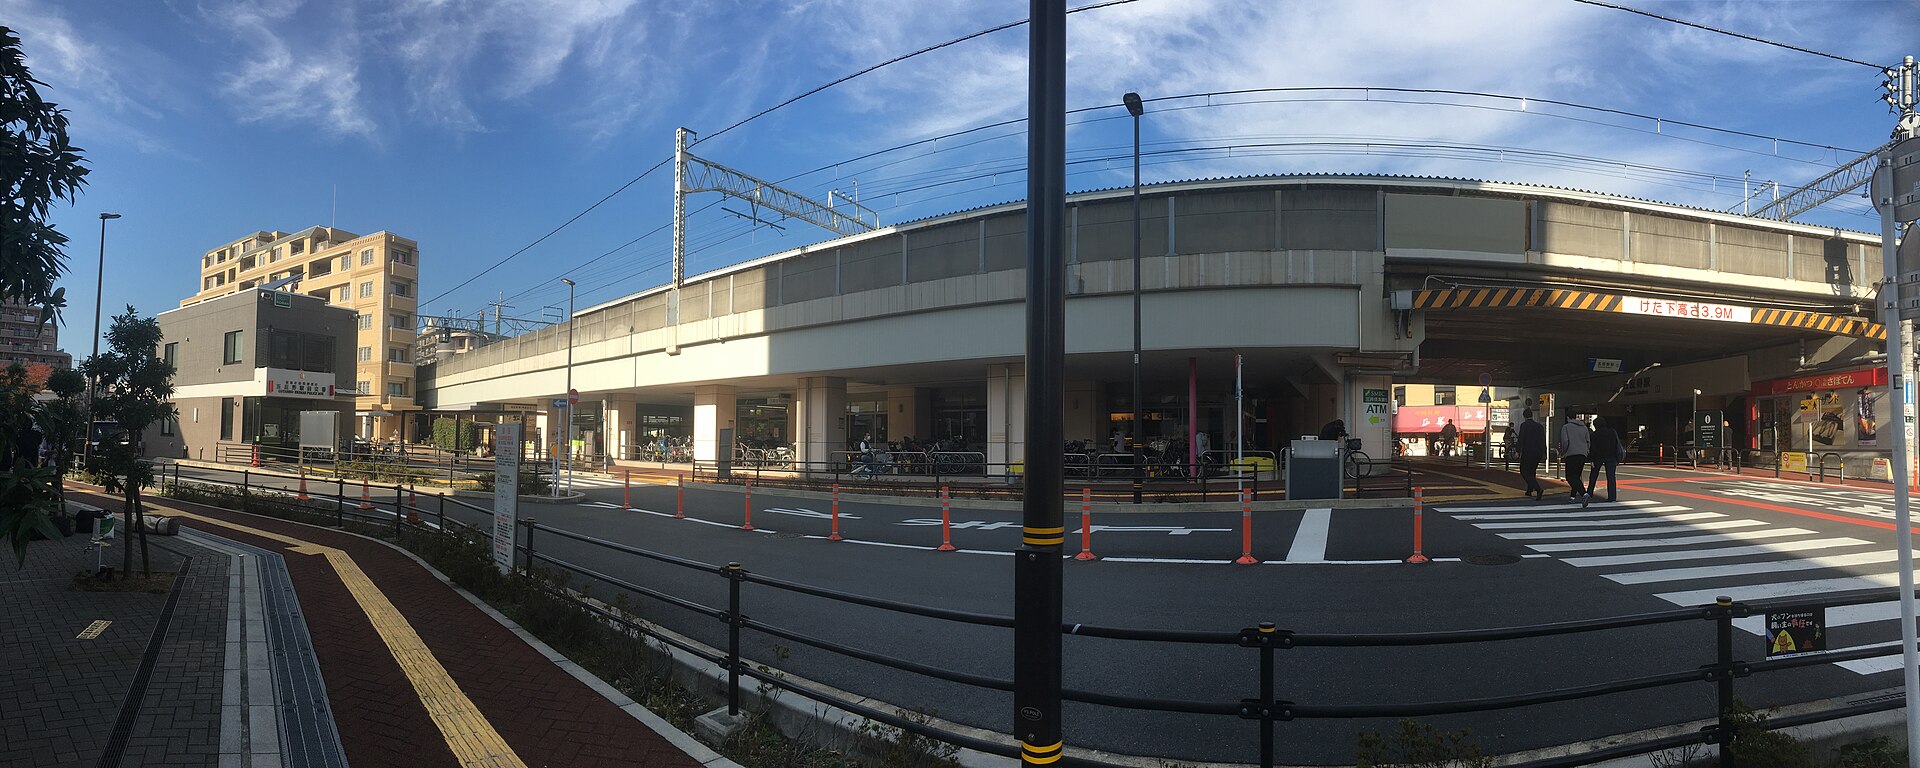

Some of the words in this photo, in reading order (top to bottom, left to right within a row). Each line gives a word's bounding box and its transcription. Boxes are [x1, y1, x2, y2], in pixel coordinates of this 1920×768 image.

[1640, 300, 1733, 319] けた下高さ3.9M
[1786, 380, 1813, 390] とんかつ
[1827, 375, 1855, 386] さぼてん
[1366, 404, 1387, 414] ATM
